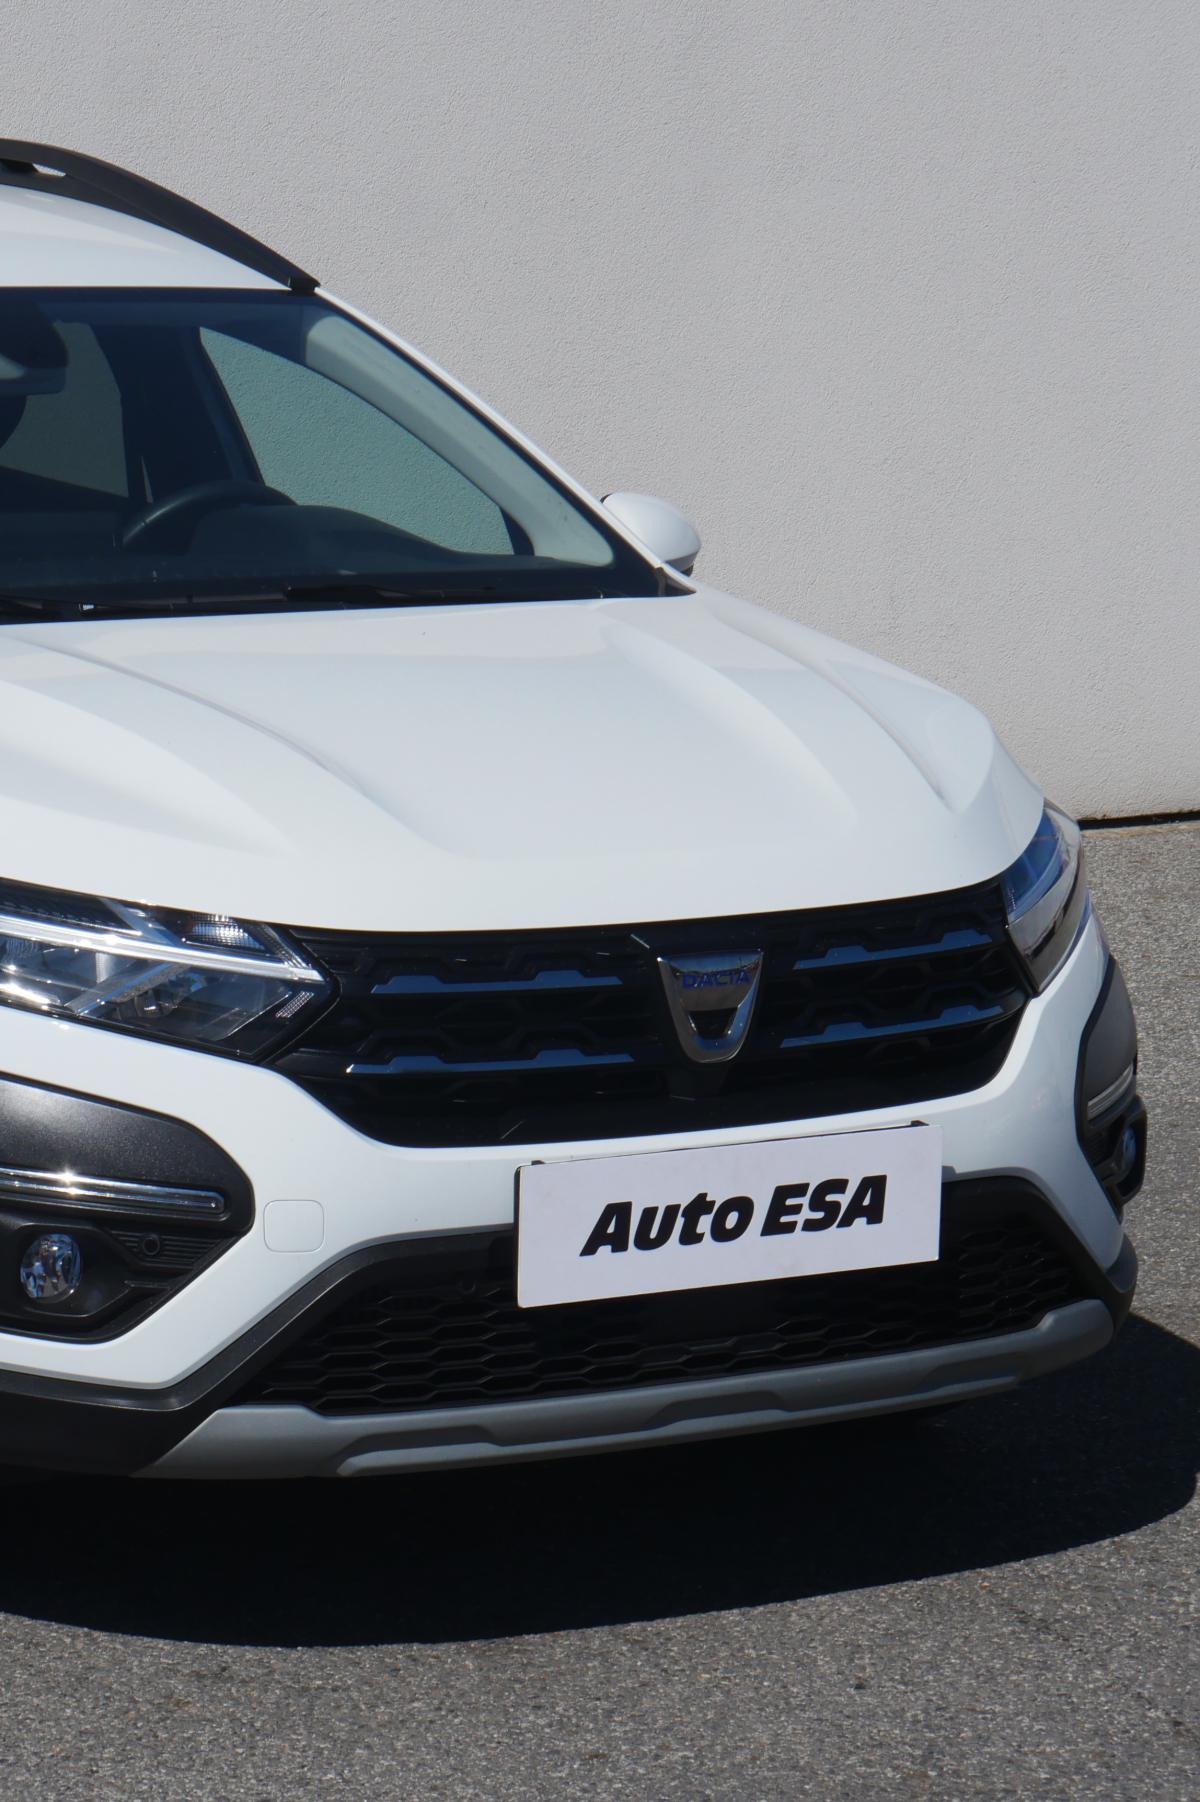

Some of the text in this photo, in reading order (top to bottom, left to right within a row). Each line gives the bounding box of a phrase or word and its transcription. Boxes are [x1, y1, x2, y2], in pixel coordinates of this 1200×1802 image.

[682, 968, 751, 990] DACIA
[579, 1174, 888, 1257] Auto ESA
